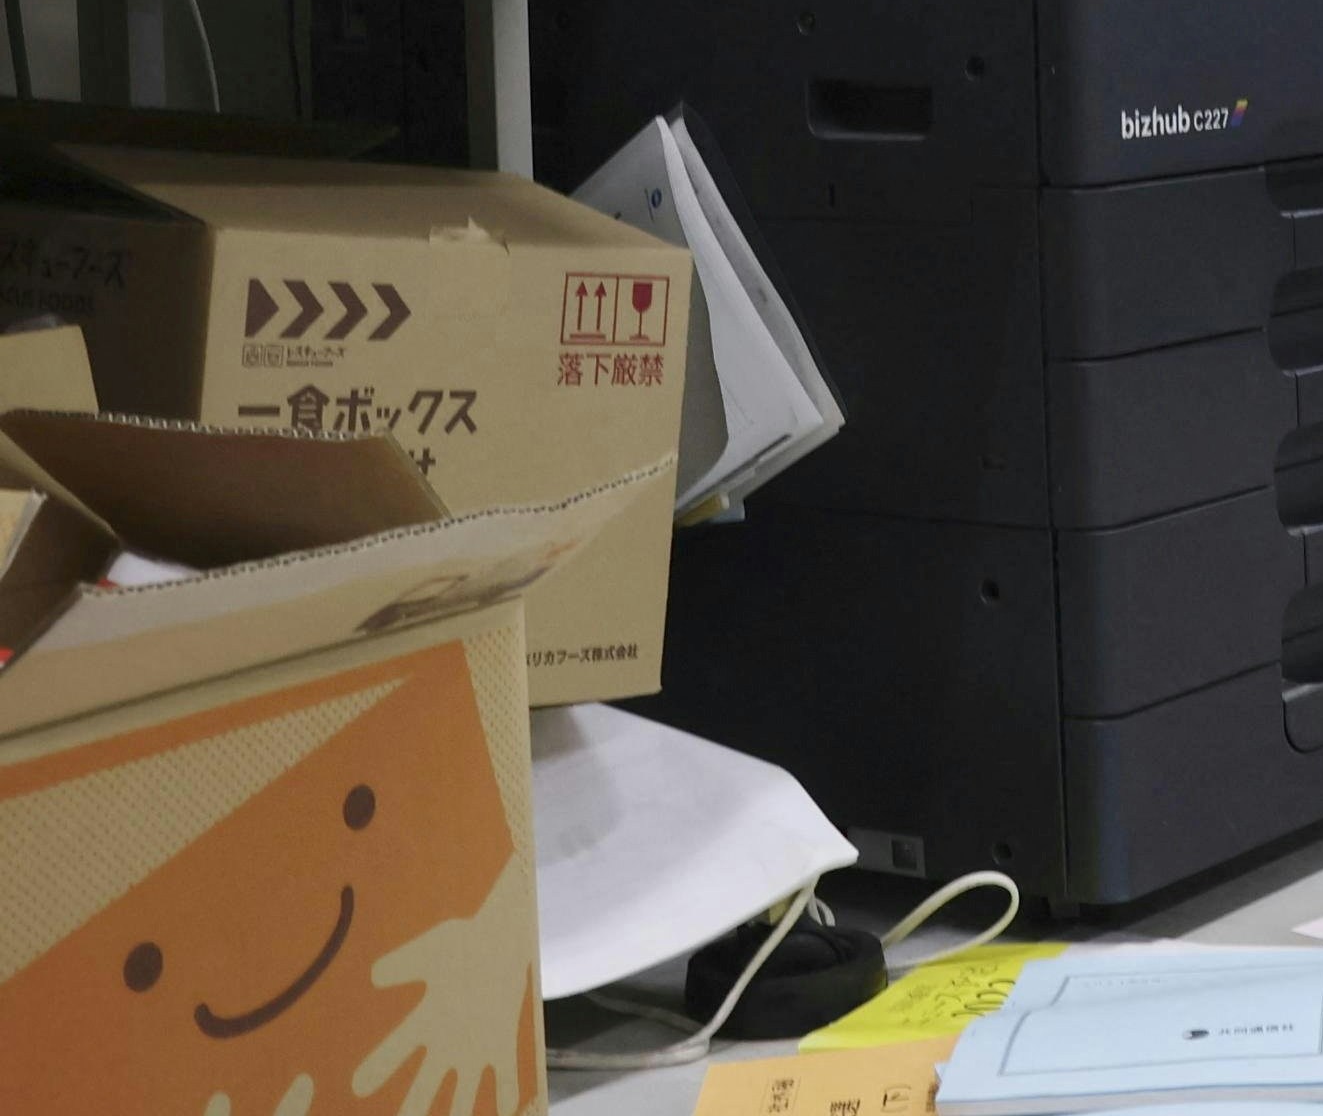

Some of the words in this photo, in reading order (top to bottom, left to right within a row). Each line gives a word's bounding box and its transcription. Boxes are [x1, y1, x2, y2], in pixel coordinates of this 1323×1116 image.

[1121, 104, 1190, 140] bizhub
[557, 352, 665, 385] 落下厳禁
[238, 385, 478, 433] 一食ボックス
